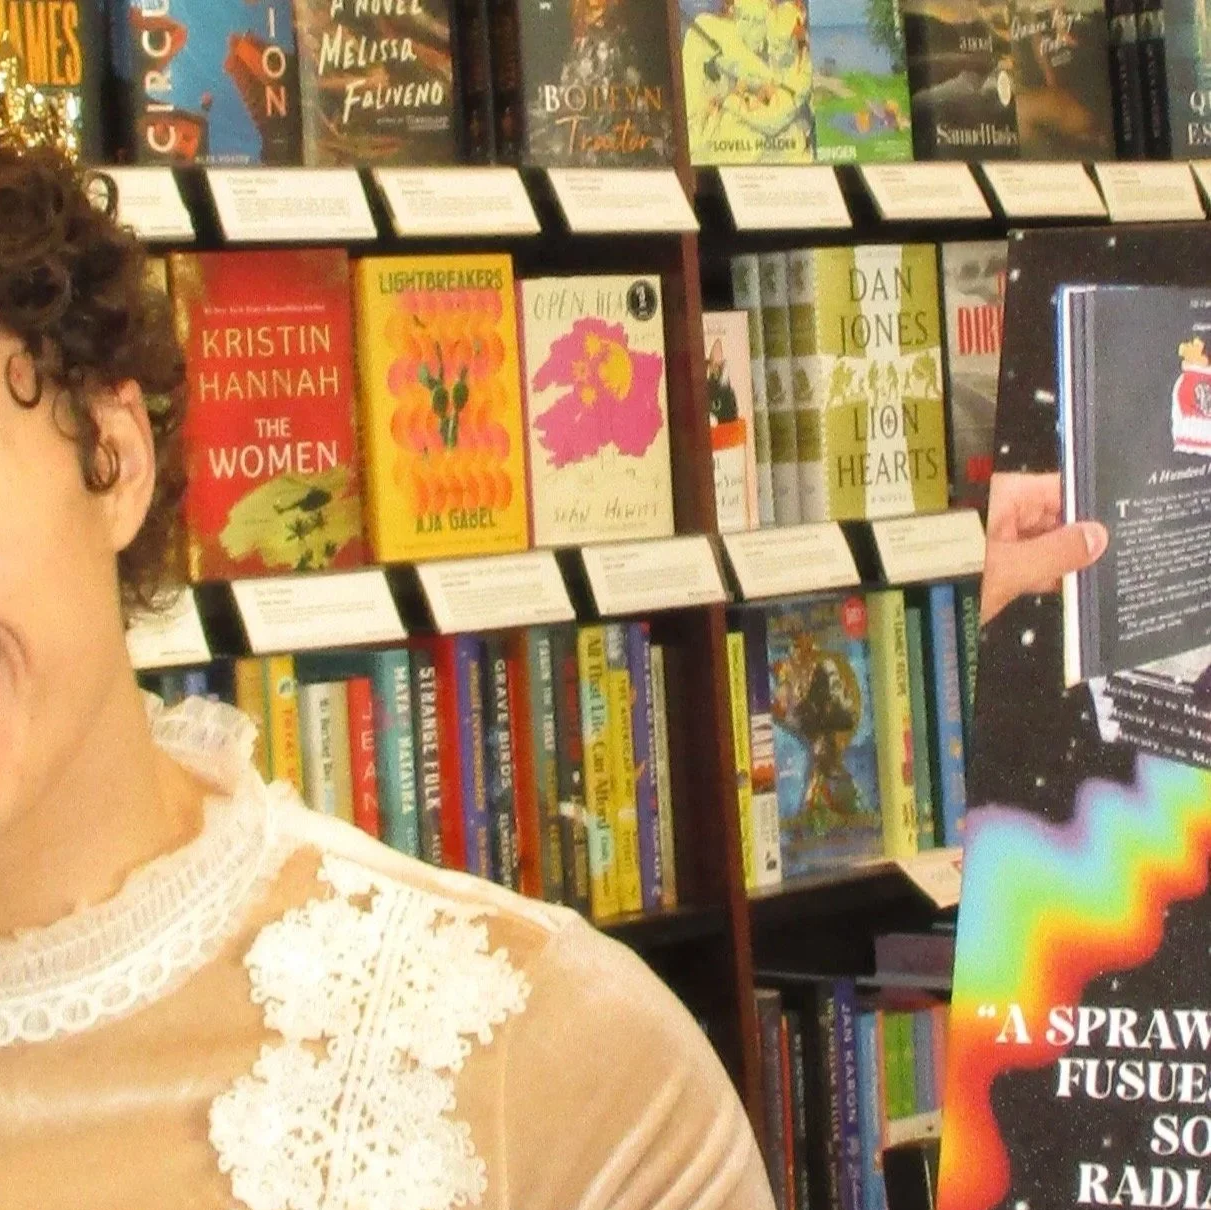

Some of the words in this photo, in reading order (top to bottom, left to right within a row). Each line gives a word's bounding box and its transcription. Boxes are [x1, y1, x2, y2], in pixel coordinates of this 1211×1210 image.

[378, 267, 504, 295] LIGHTBREAKERS
[849, 266, 913, 302] DAN
[201, 323, 331, 360] KRISTIN
[837, 311, 929, 357] JONES
[198, 365, 340, 403] HANNAH
[254, 415, 292, 438] THE
[852, 403, 920, 442] LION
[207, 439, 338, 480] WOMEN
[837, 447, 938, 489] HEARTS
[416, 511, 443, 535] AJA
[448, 508, 496, 532] GABEL
[586, 634, 602, 659] All
[494, 658, 510, 722] GRAVE
[588, 663, 605, 702] That
[418, 665, 438, 755] STRANGE
[590, 704, 606, 736] Life
[496, 730, 512, 791] BIRDS
[593, 740, 610, 774] Can
[425, 761, 442, 813] FOLK
[595, 779, 611, 830] Afford
[840, 1002, 854, 1043] JAN
[1044, 1004, 1211, 1053] SPRAW
[843, 1050, 857, 1124] KARON
